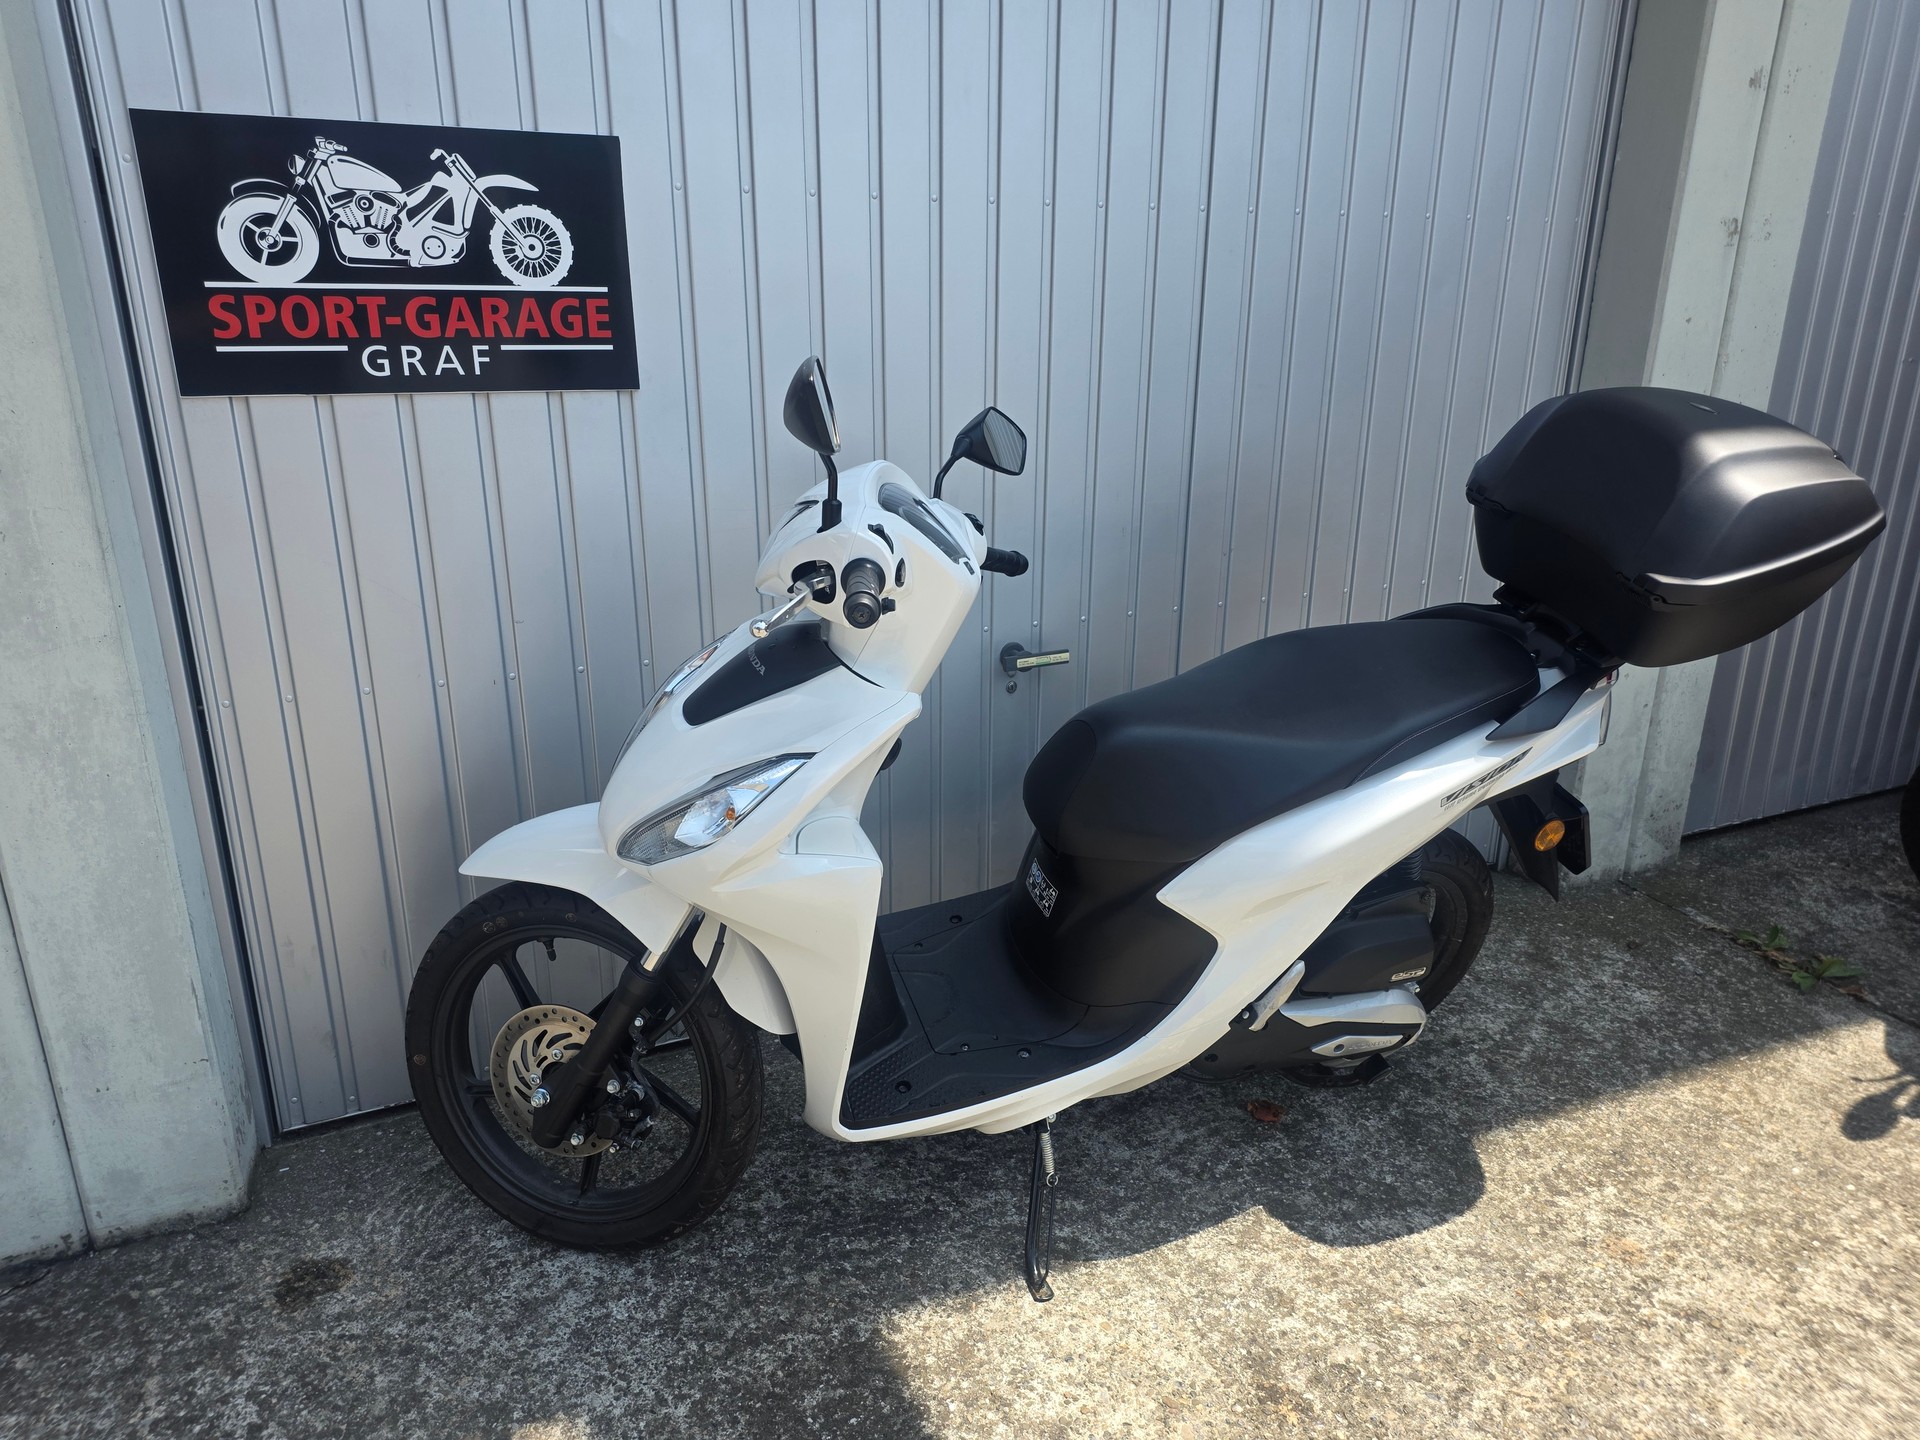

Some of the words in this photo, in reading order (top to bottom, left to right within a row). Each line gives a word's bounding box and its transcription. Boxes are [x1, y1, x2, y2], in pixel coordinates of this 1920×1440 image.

[208, 294, 613, 339] SPORT-GARAGE
[361, 345, 491, 377] GRAF
[747, 644, 766, 676] ONDA
